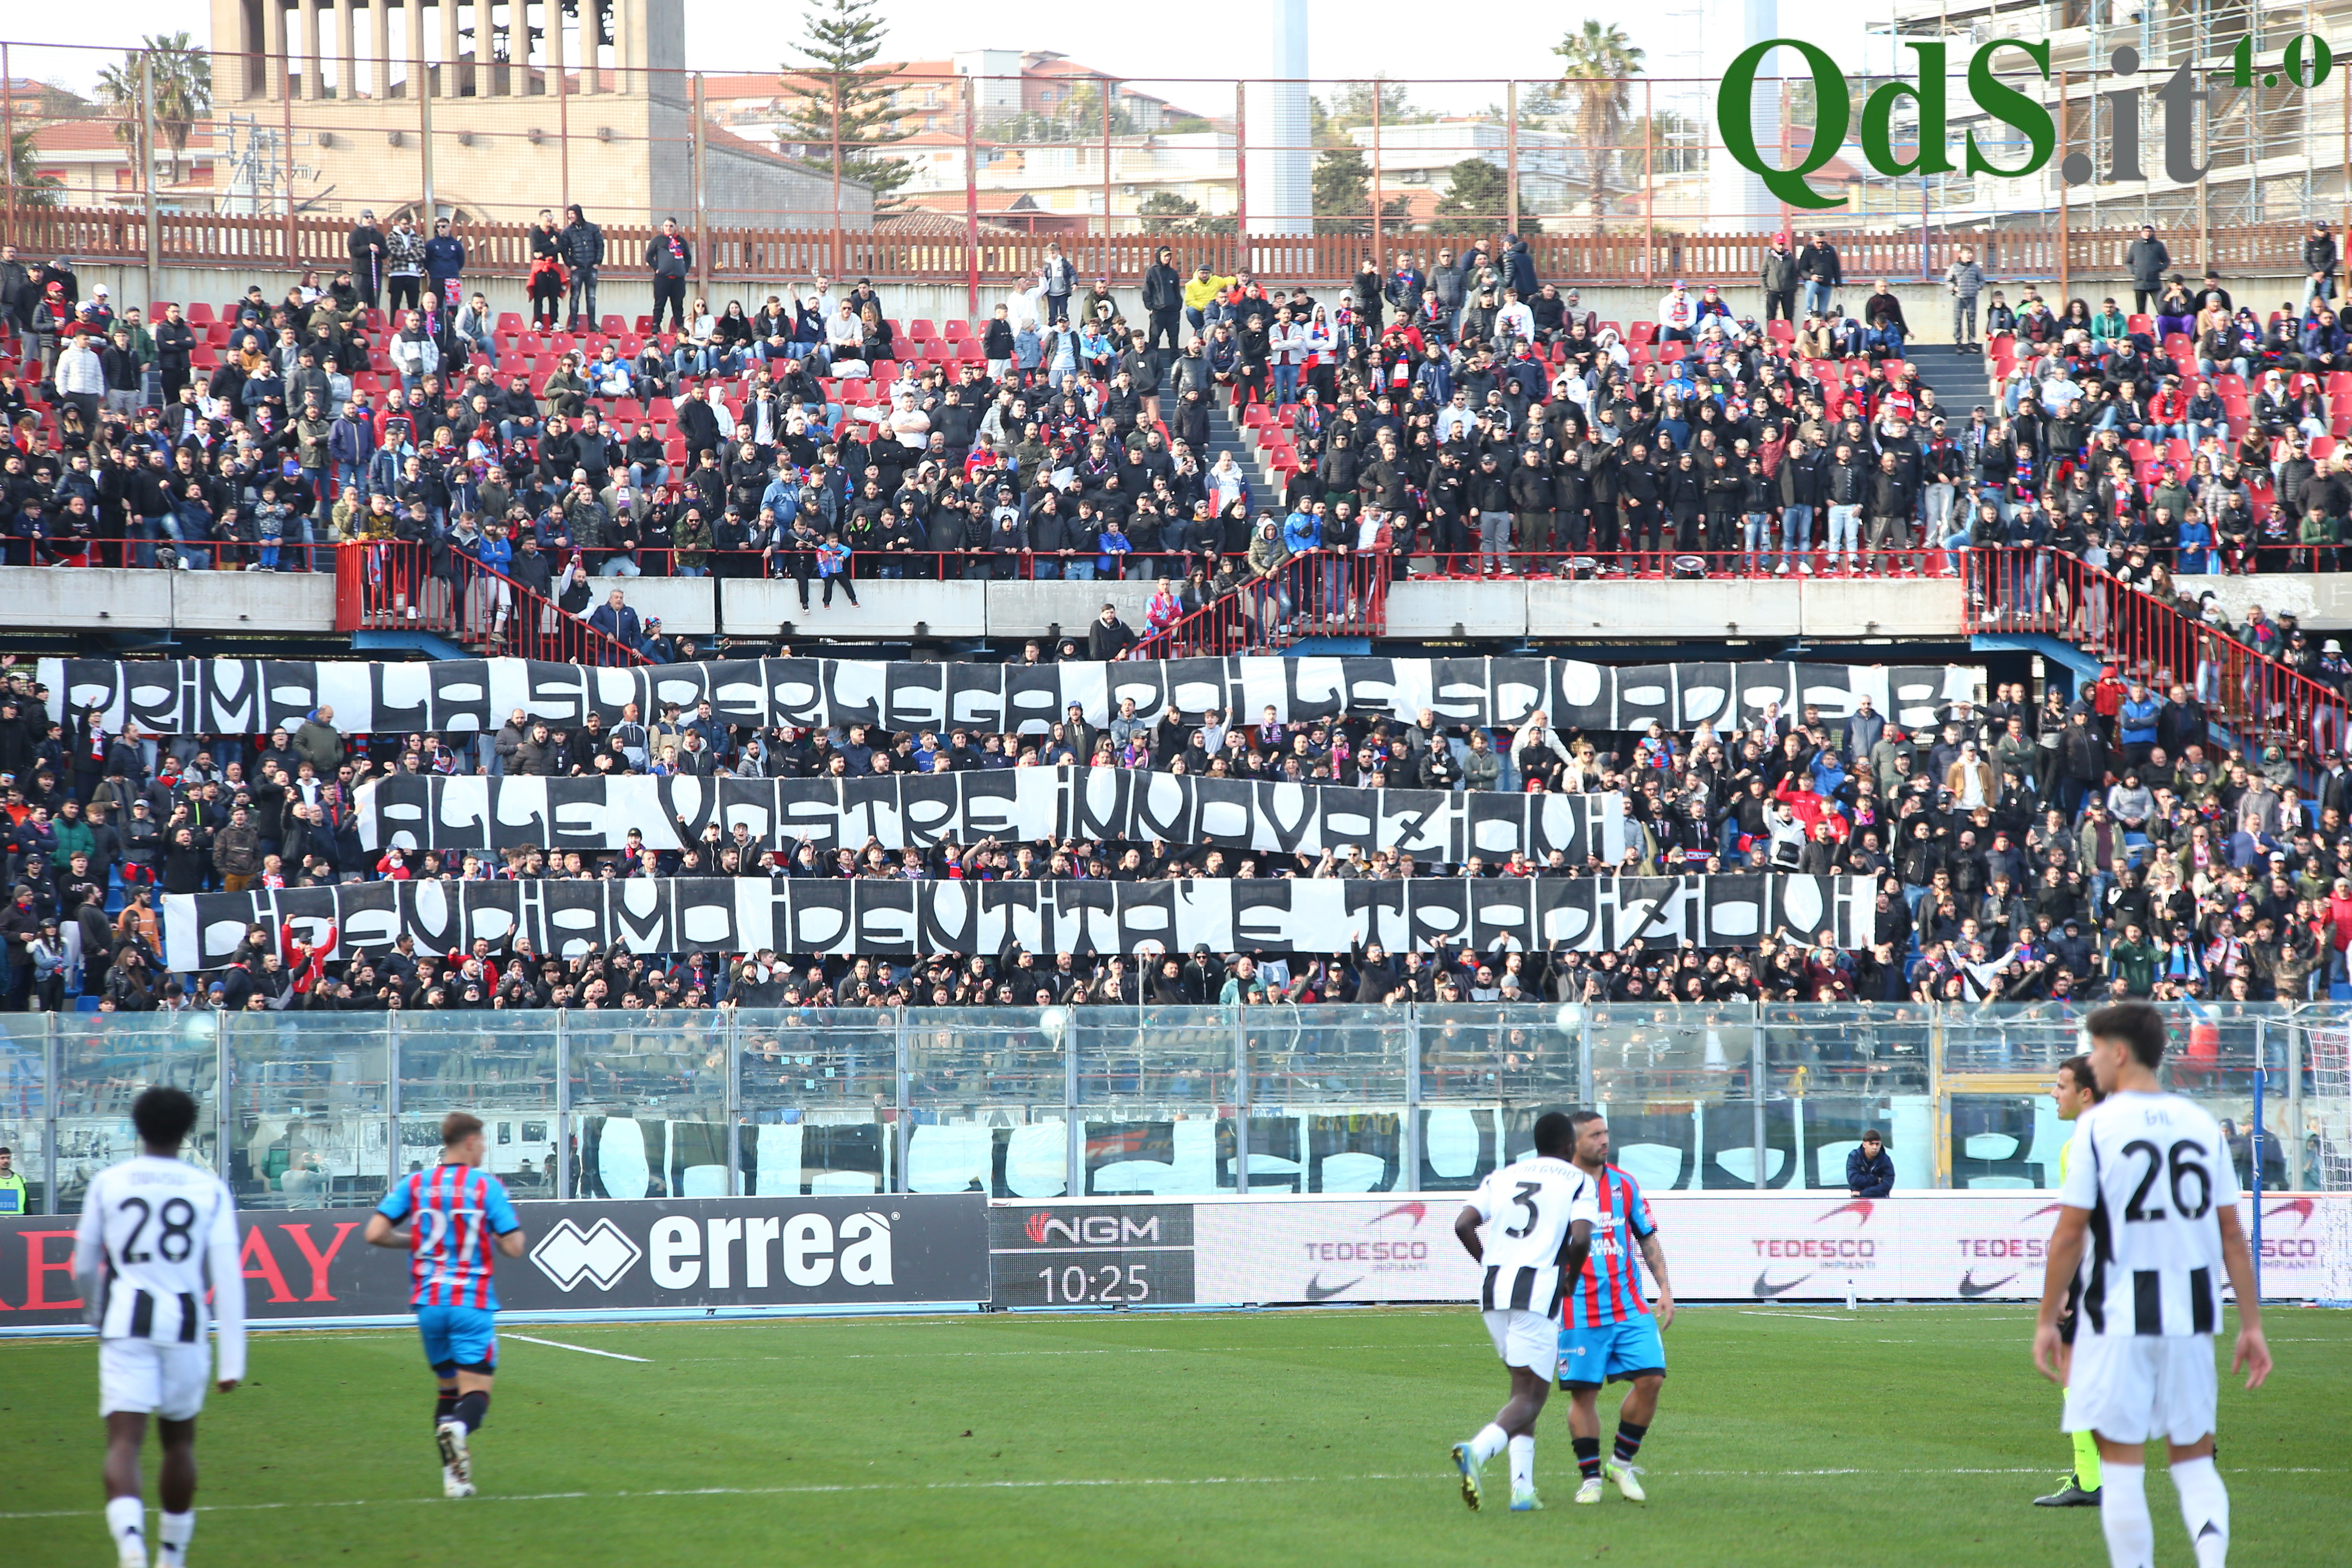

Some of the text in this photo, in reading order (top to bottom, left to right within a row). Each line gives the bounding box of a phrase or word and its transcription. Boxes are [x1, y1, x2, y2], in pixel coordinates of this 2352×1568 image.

[2120, 1139, 2212, 1223] 26
[120, 1197, 195, 1264] 28
[1044, 1215, 1160, 1245] NGM
[1505, 1181, 1542, 1239] 3
[412, 1208, 485, 1262] 27
[1305, 1242, 1427, 1261] TEDESCO
[1752, 1239, 1875, 1257] TEDESCO
[1039, 1264, 1149, 1303] 10:25
